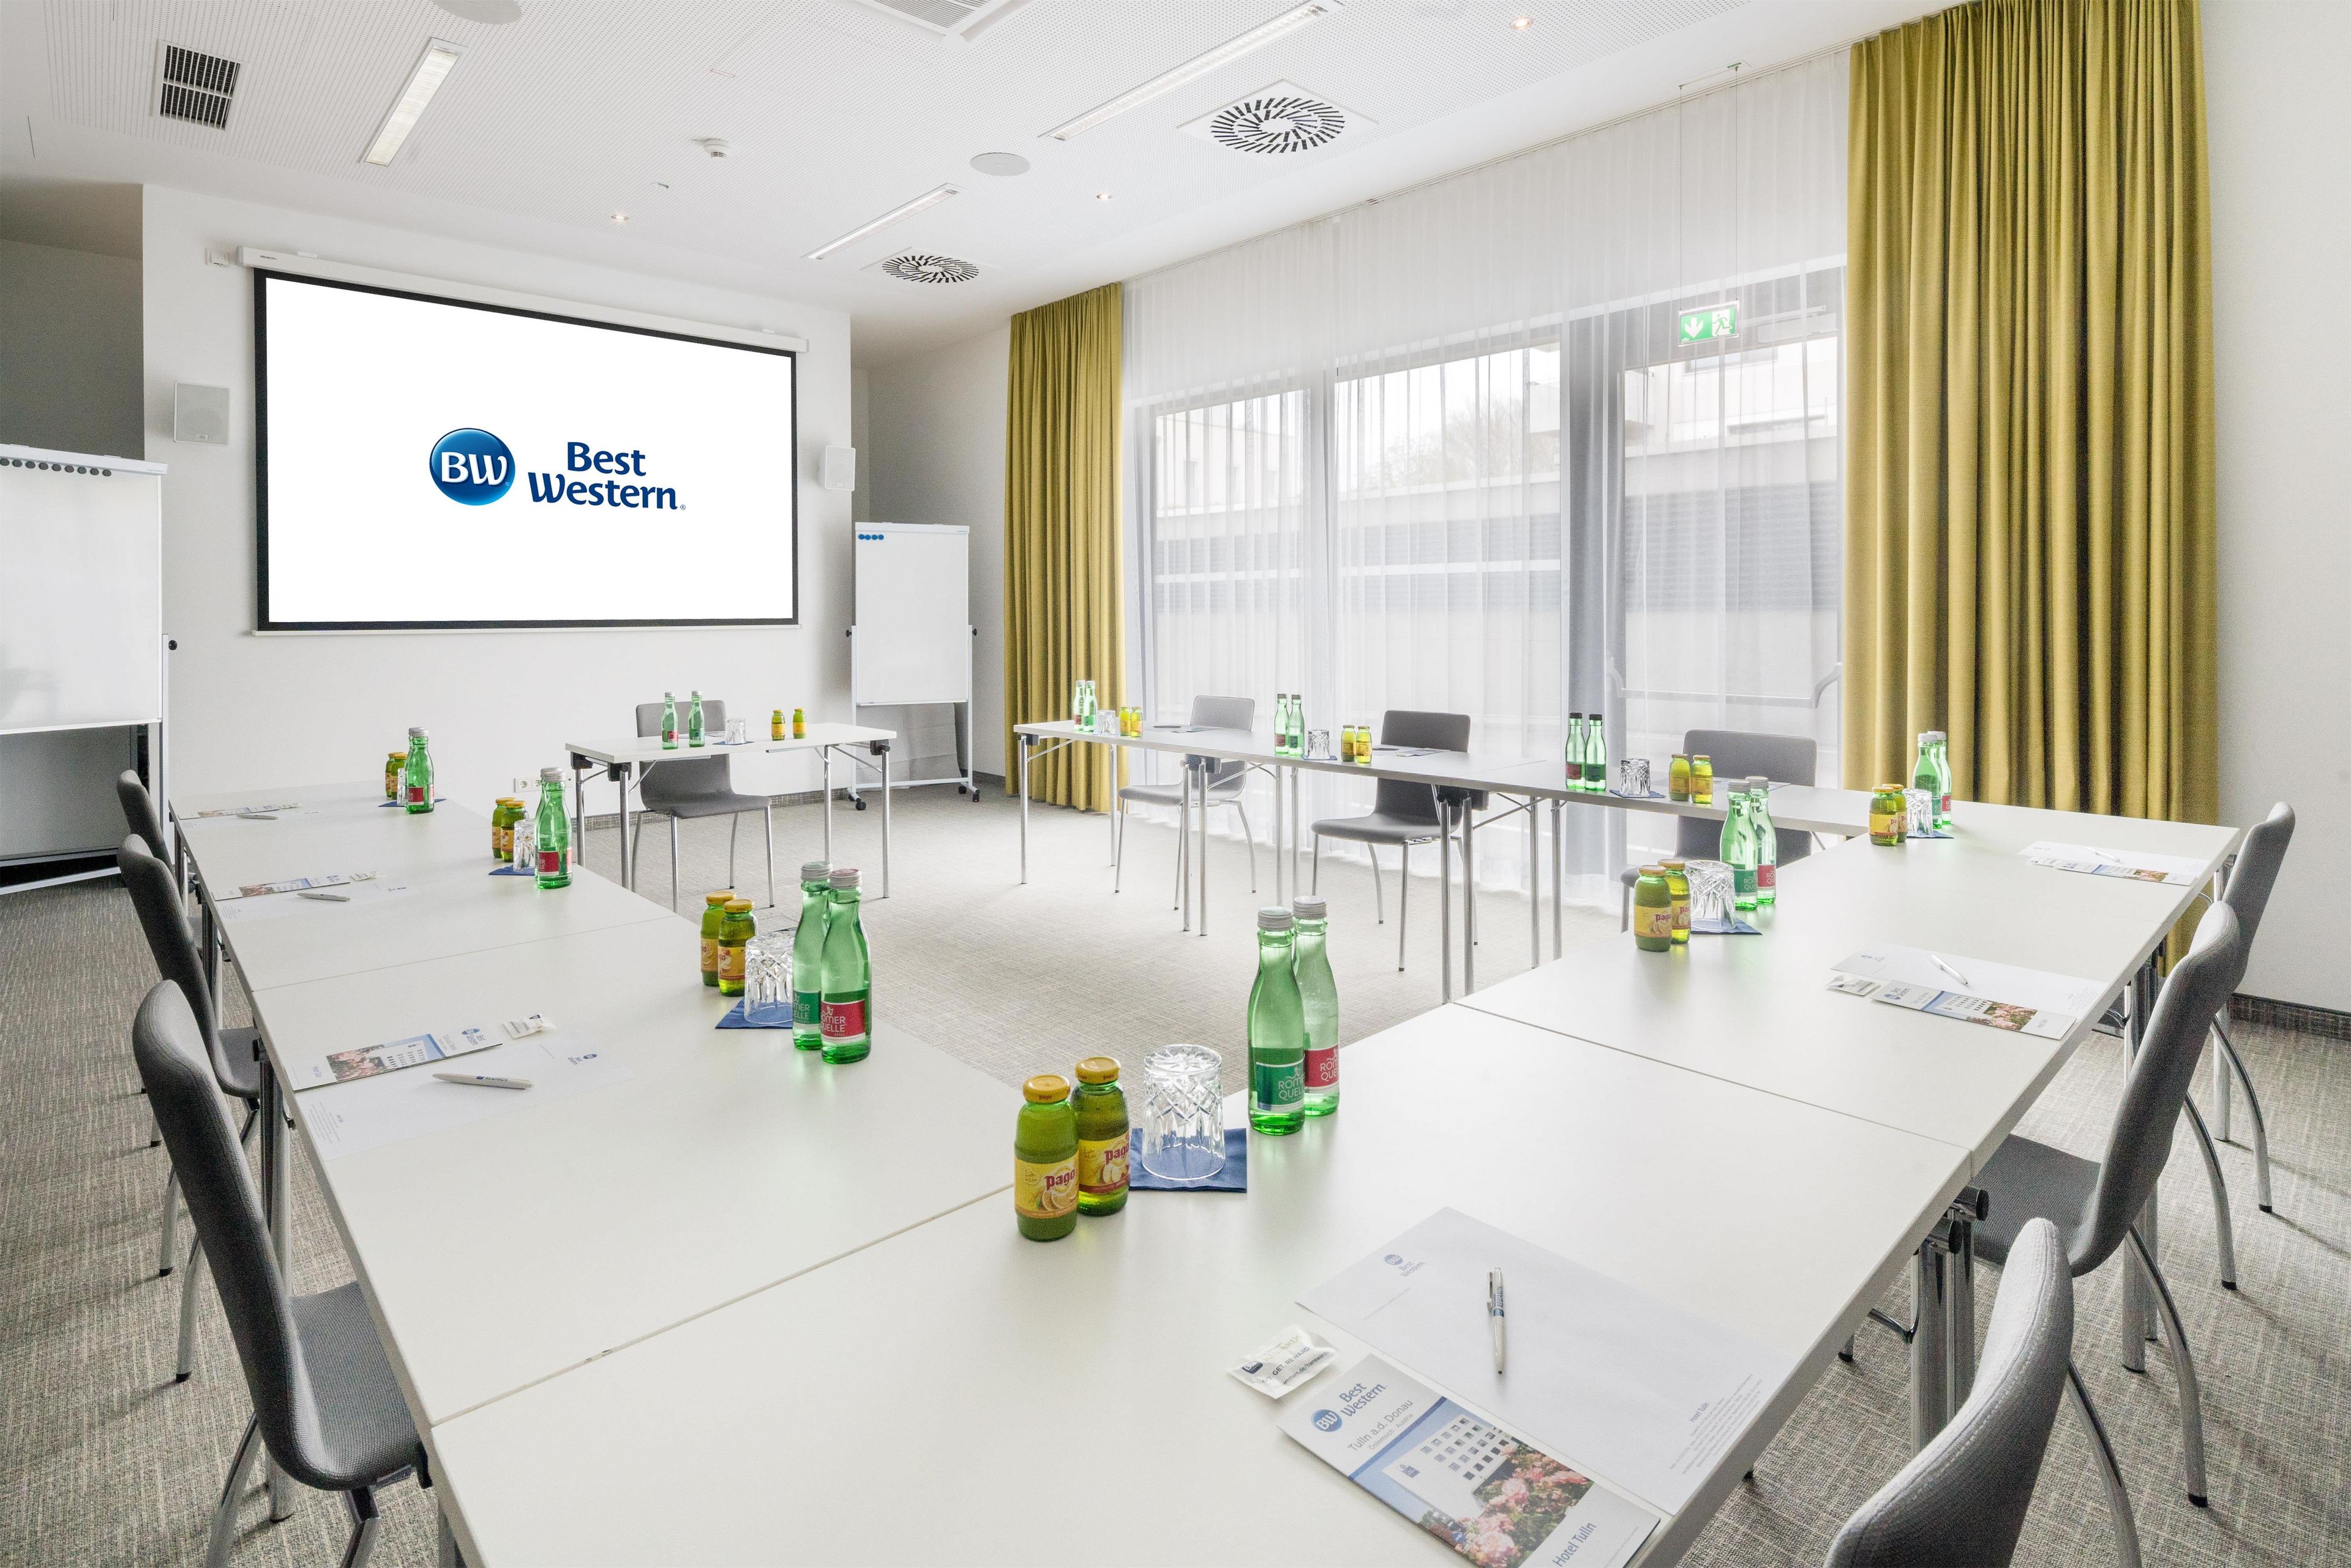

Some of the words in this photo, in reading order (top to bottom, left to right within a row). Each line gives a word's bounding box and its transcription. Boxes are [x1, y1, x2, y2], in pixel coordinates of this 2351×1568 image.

[441, 451, 508, 486] BW
[567, 441, 647, 477] Best
[1044, 1168, 1076, 1191] pago
[1339, 1382, 1367, 1403] Best
[1316, 1411, 1339, 1430] BW
[1348, 1433, 1373, 1452] Tulln
[1371, 1421, 1388, 1436] a.d.
[1384, 1400, 1414, 1424] Donau
[1552, 1541, 1580, 1567] Hotel
[1572, 1522, 1597, 1544] Tulln
